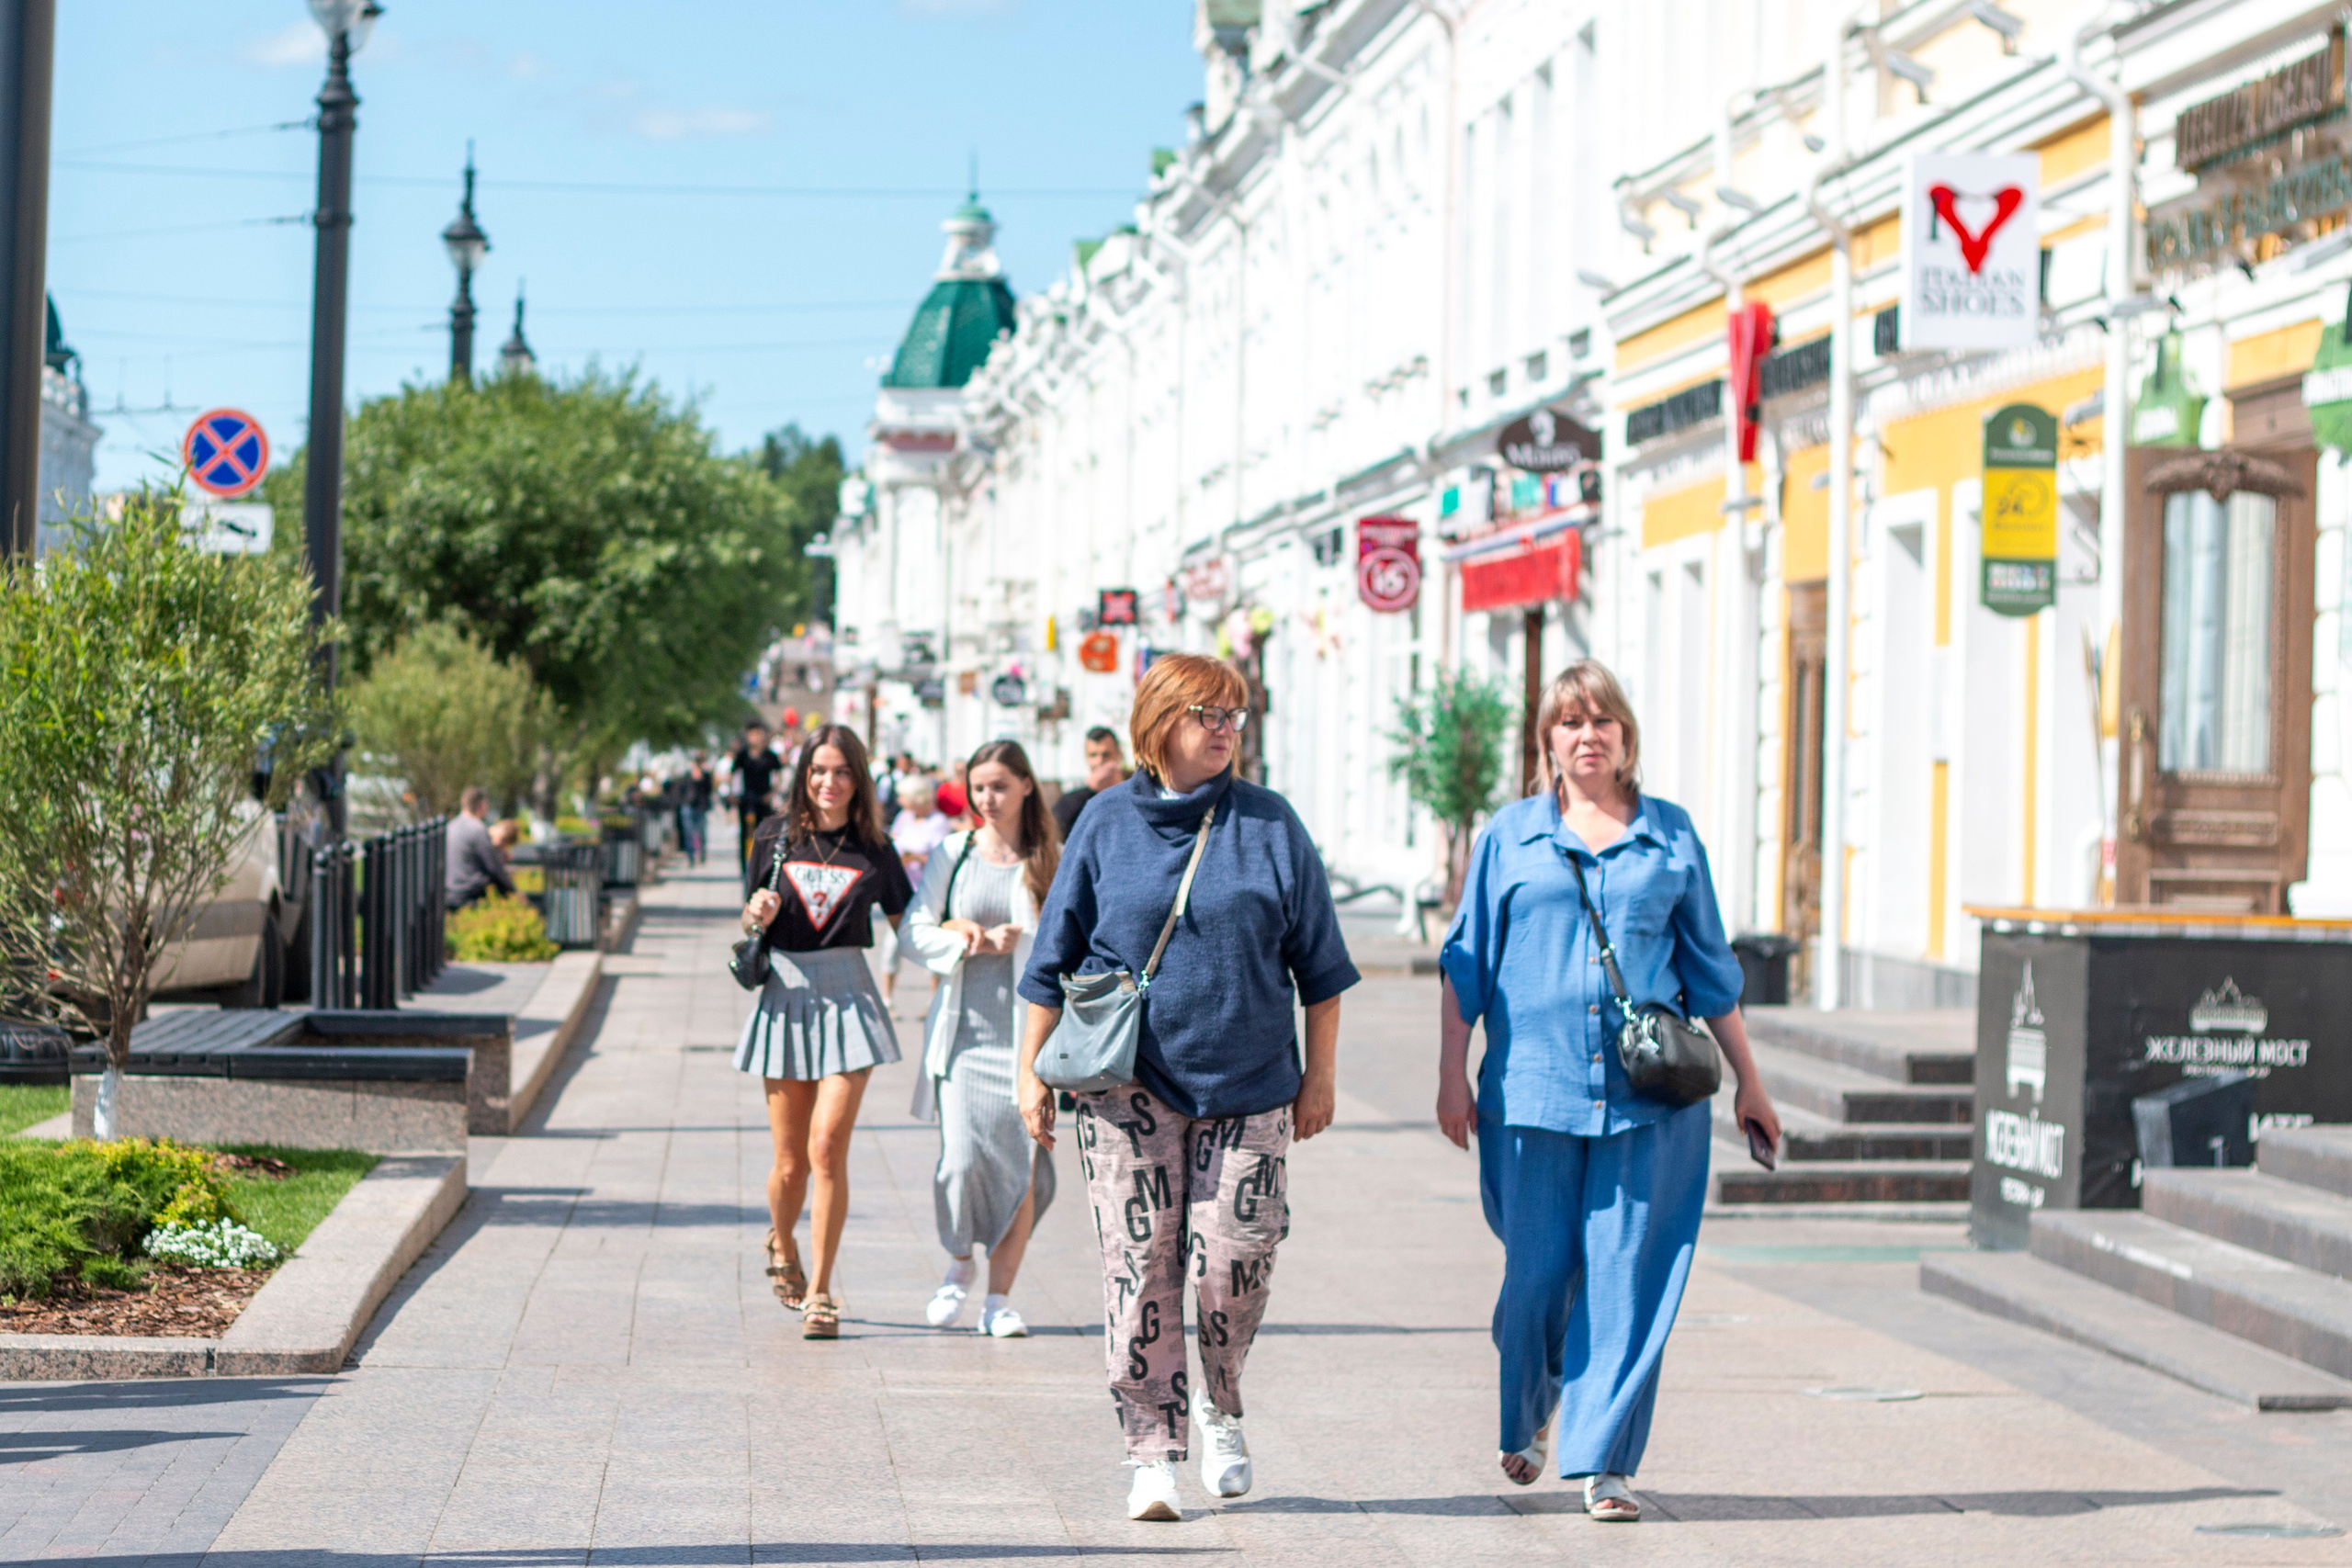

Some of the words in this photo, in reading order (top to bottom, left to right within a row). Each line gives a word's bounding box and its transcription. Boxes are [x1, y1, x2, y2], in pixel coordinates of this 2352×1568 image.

[1921, 289, 2026, 316] SHOES
[795, 866, 846, 884] GUESS
[2144, 1034, 2256, 1066] ЖЕЛЕЗНЫЙ
[2257, 1039, 2311, 1067] МОСТ
